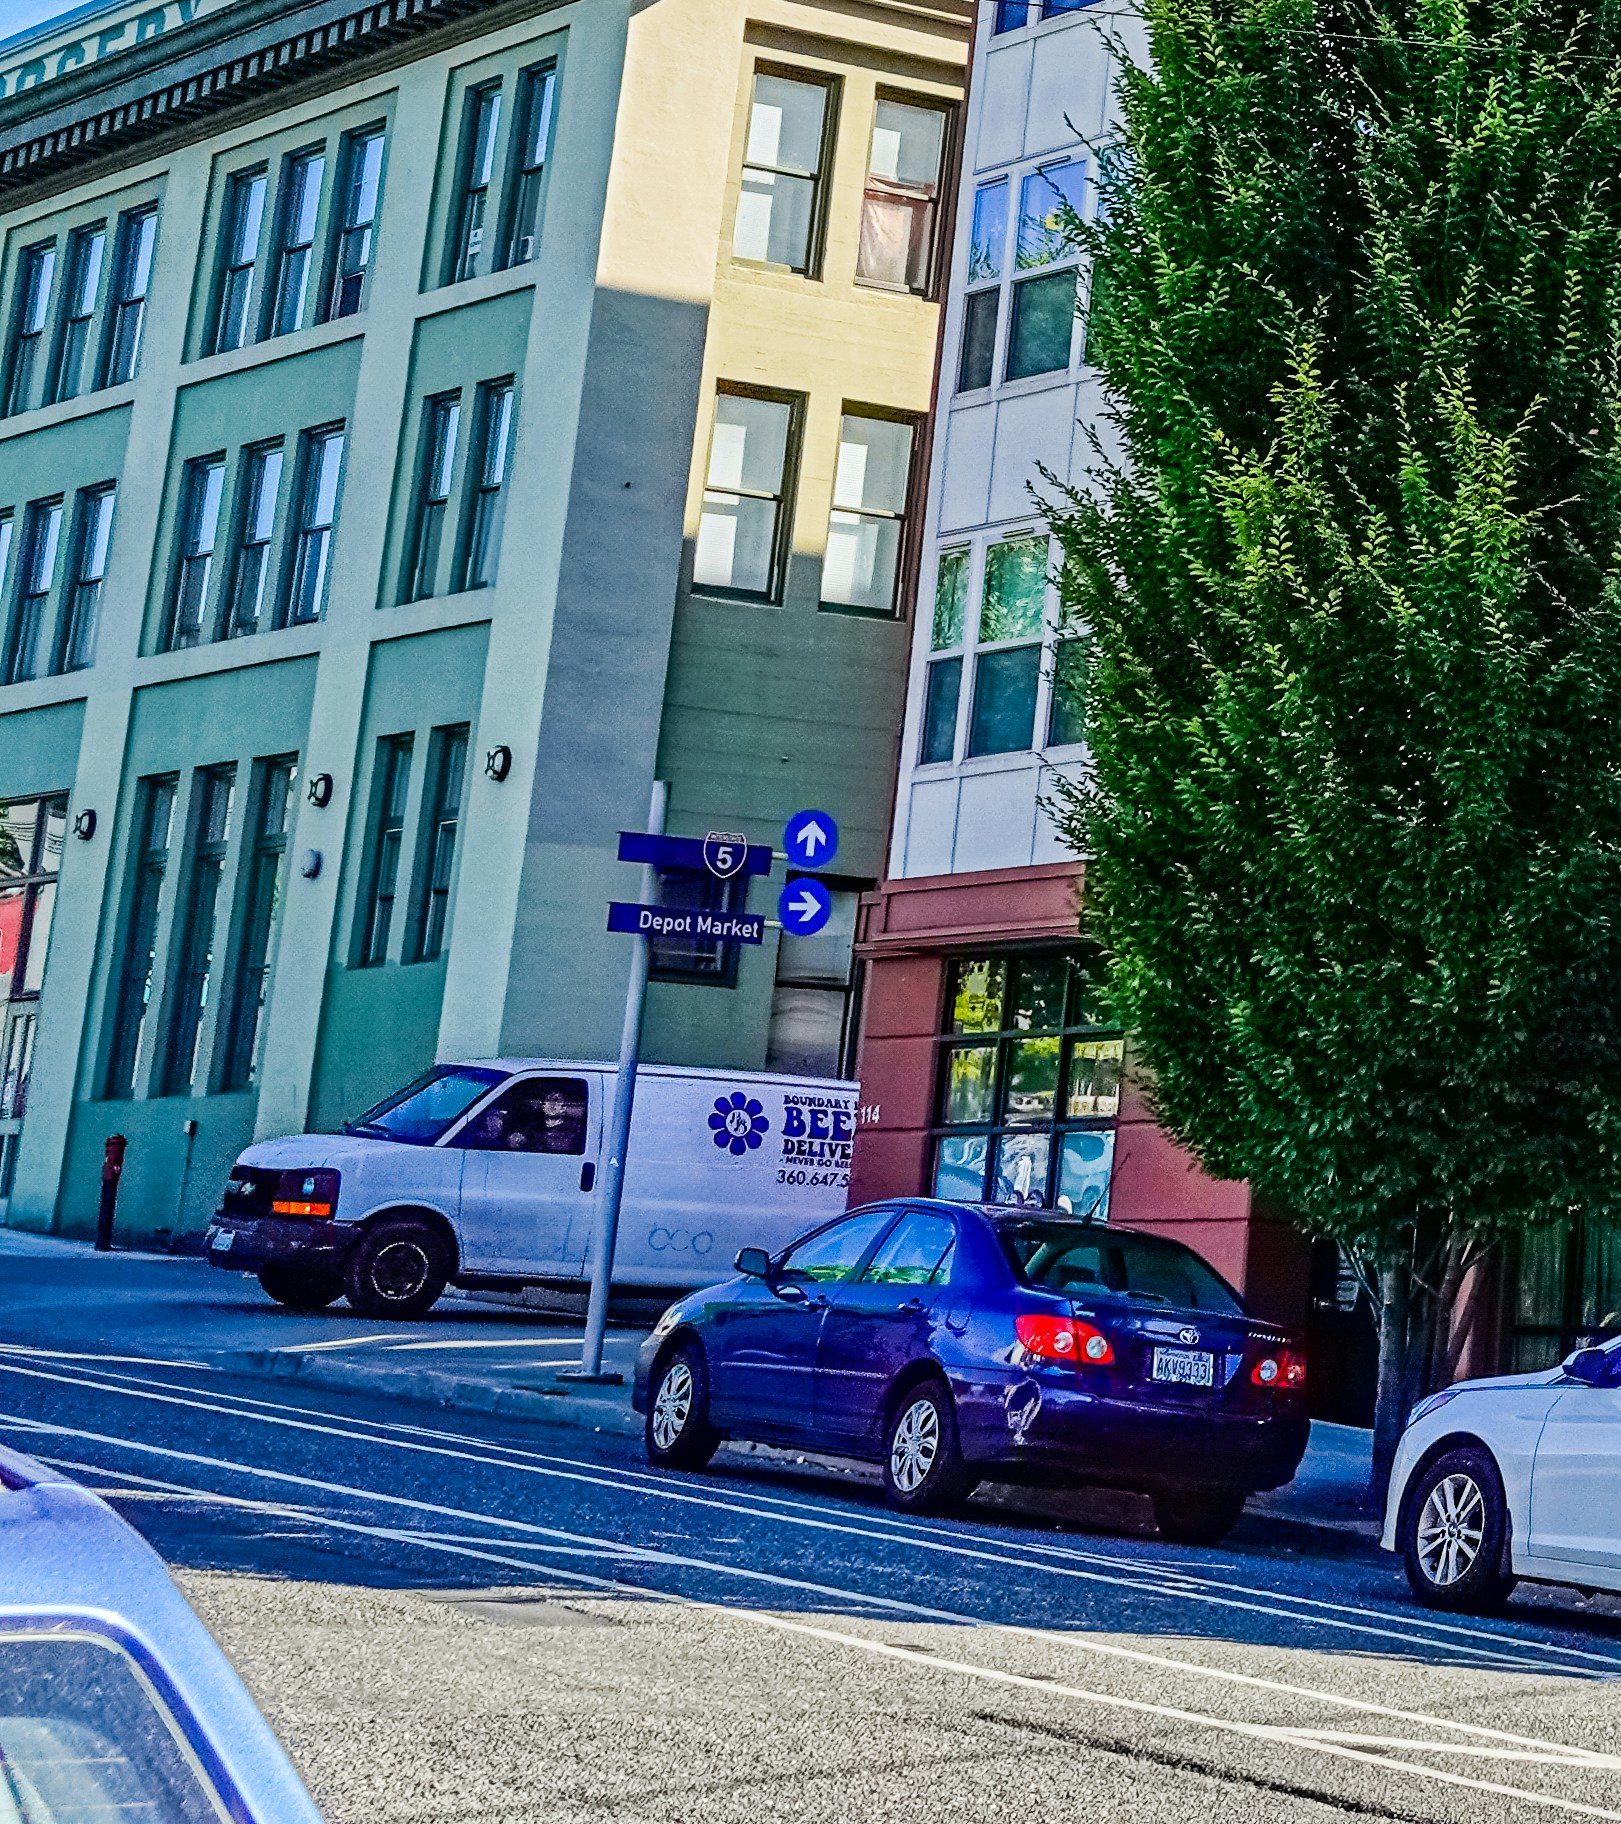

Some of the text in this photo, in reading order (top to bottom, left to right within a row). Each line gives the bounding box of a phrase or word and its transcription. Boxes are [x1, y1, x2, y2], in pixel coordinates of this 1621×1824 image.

[716, 846, 733, 870] 5
[639, 910, 759, 938] Depot Market
[783, 1094, 850, 1110] BOUNDARY
[781, 1106, 857, 1141] BEE
